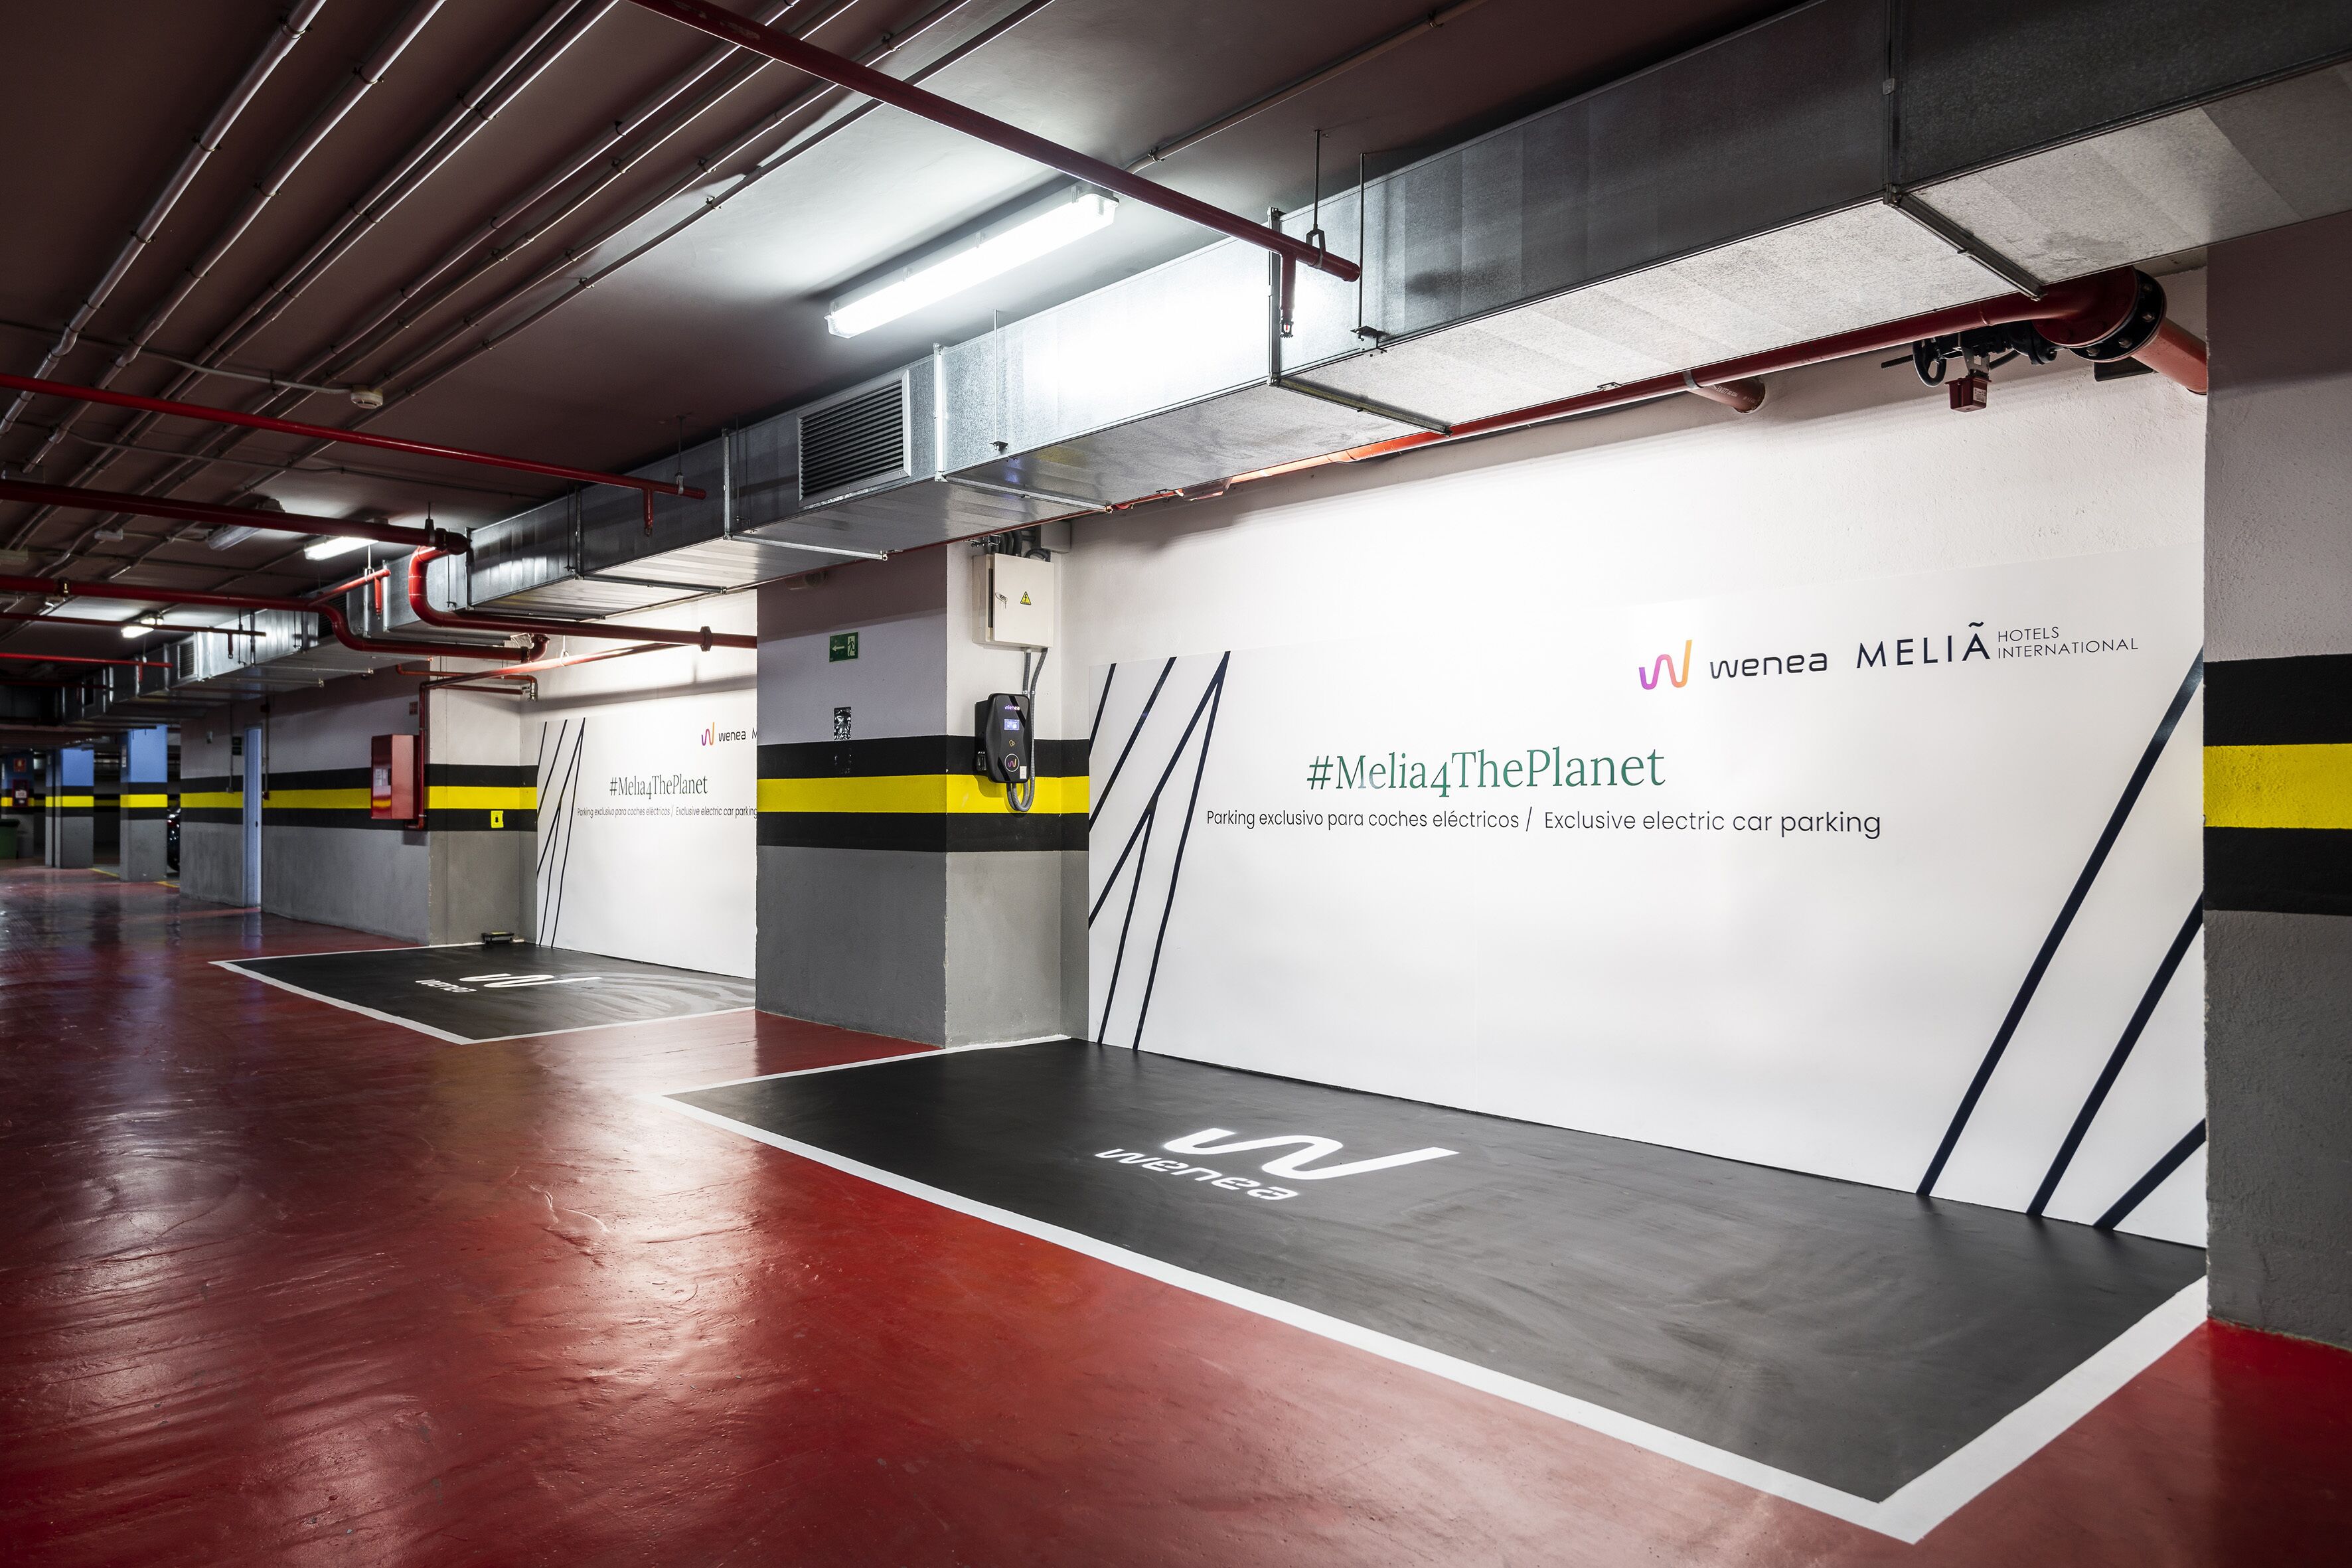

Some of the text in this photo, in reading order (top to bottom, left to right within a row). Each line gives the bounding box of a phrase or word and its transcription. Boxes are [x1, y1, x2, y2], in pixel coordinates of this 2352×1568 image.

[1998, 626, 2059, 643] HOTELS
[1998, 638, 2139, 659] INTERNATIONAL
[1709, 653, 1828, 679] wenea
[718, 730, 746, 742] wenea
[1306, 745, 1666, 798] #Melia4ThePlanet
[609, 773, 708, 800] #Melia4ThePlanet
[578, 808, 593, 818] Parking
[594, 807, 615, 816] exclusivo
[615, 809, 626, 818] para
[627, 807, 645, 816] coches
[676, 807, 700, 816] Exclusive
[700, 807, 722, 816] electric
[735, 807, 757, 819] parking
[1207, 809, 1255, 829] Parking
[1259, 809, 1323, 826] exclusivo
[1328, 813, 1364, 831] para
[1368, 810, 1427, 827] coches
[1433, 810, 1519, 828] eléctricos
[1545, 810, 1636, 829] Exclusive
[1642, 810, 1725, 830] electric
[1733, 815, 1772, 831] car
[1780, 811, 1881, 839] parking
[1095, 1148, 1299, 1200] wenea
